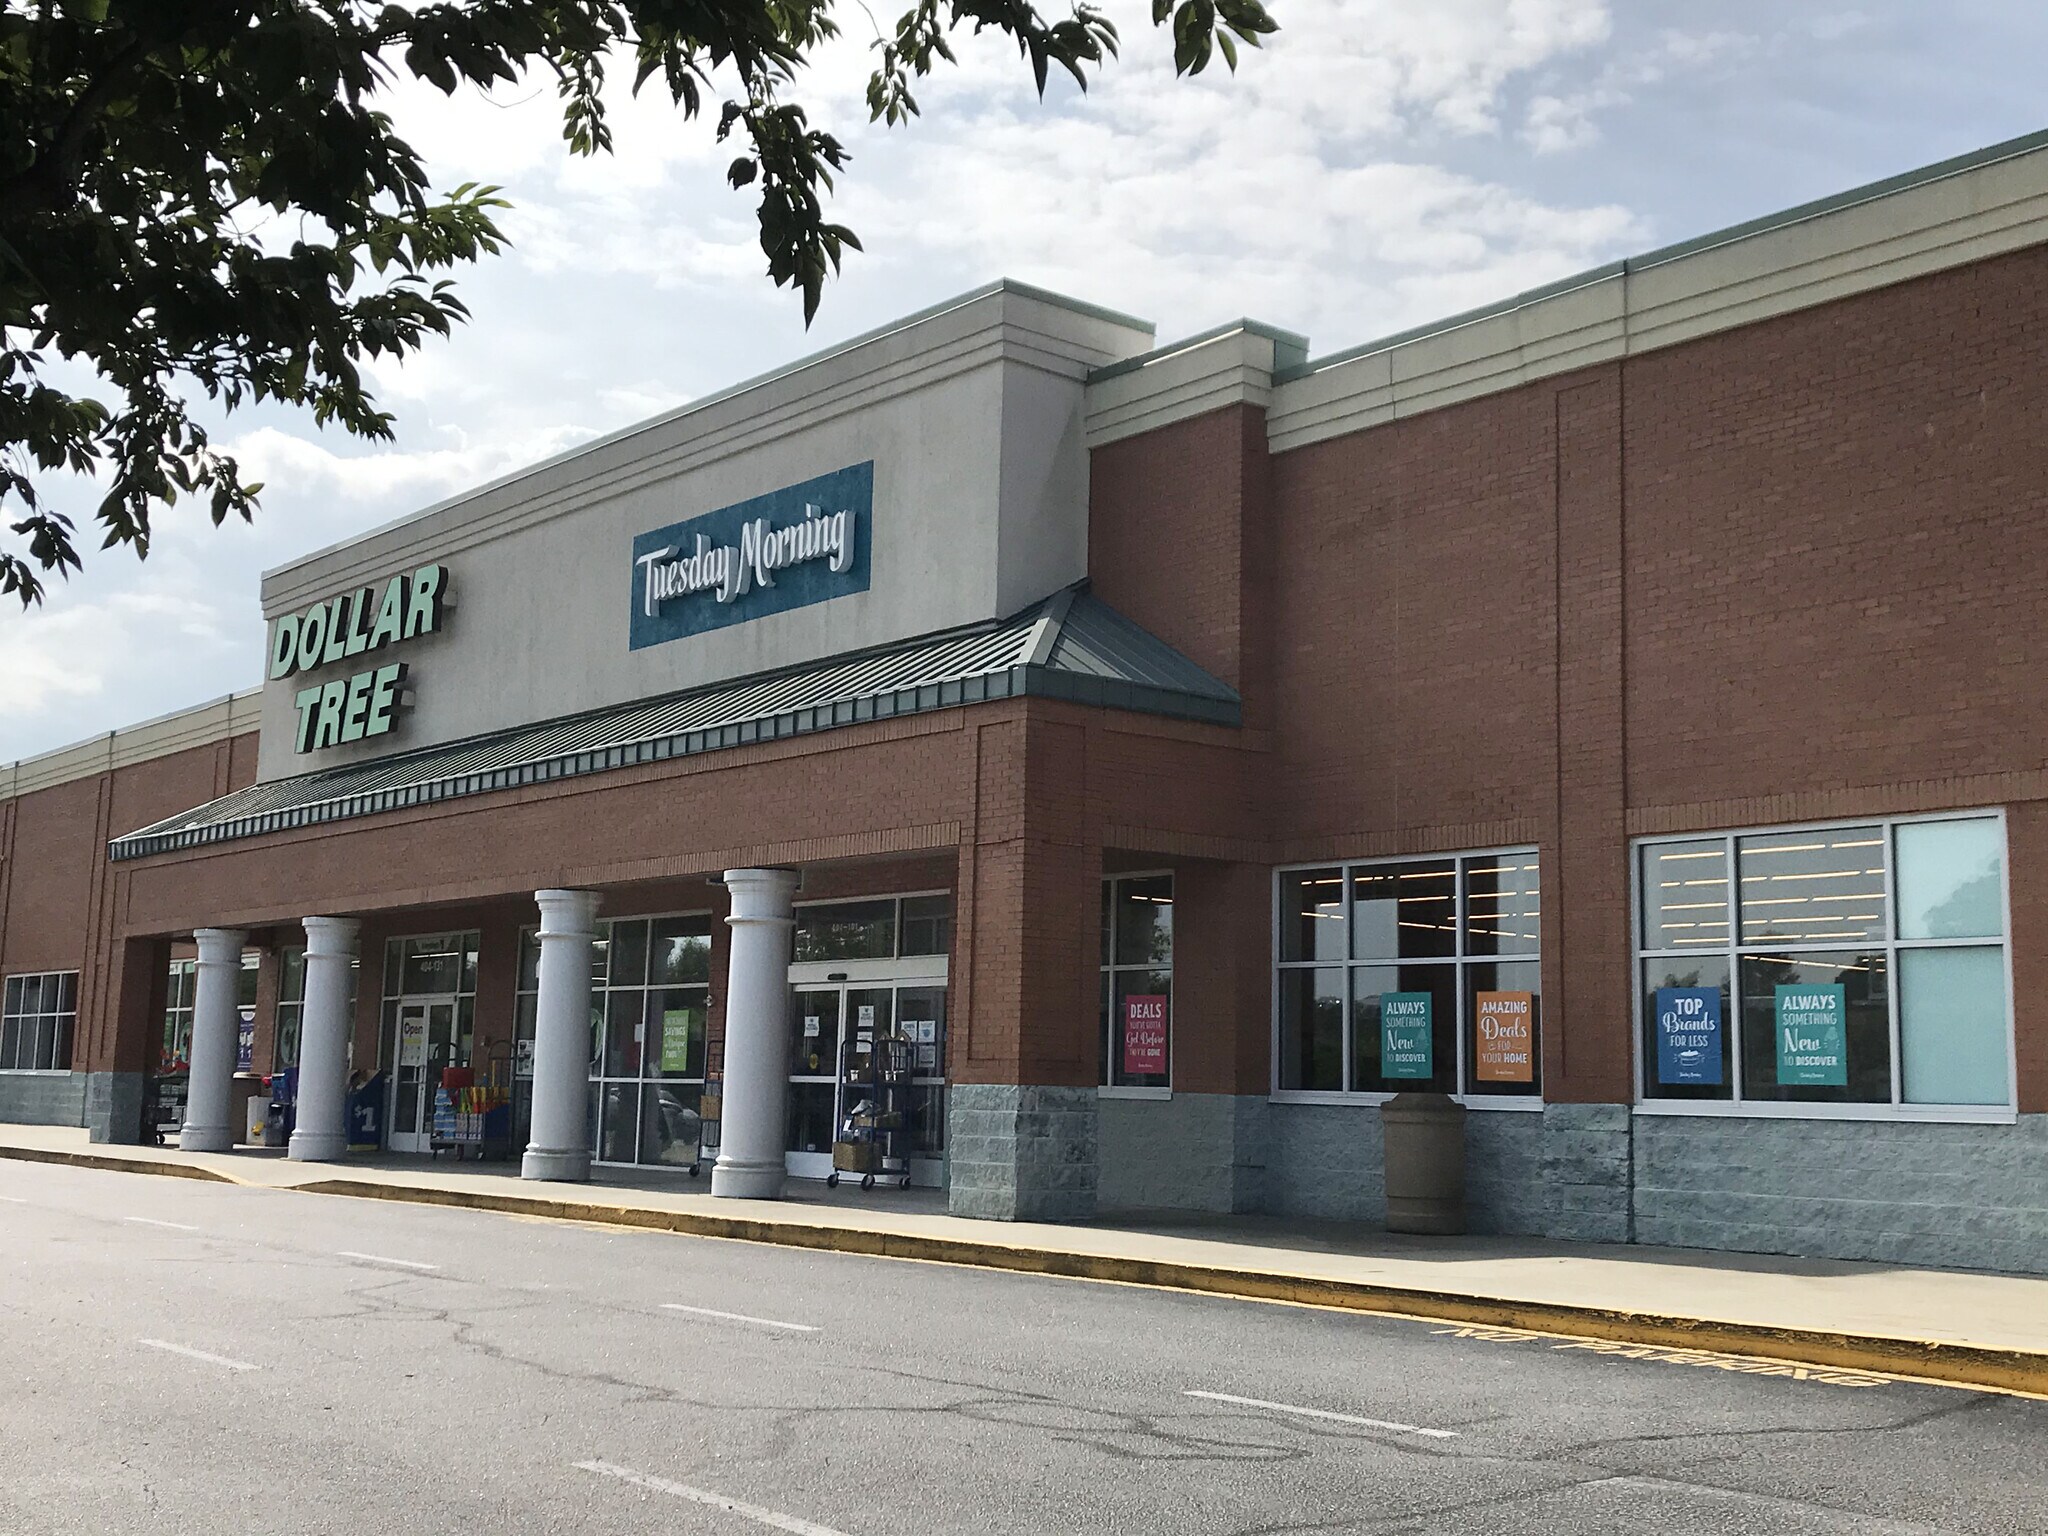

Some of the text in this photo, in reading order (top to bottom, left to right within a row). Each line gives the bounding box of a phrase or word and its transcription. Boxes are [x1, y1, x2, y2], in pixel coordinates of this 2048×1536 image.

[635, 502, 856, 617] Tuesday Morning
[270, 564, 448, 681] DOLLAR
[294, 663, 409, 754] TREE
[1386, 1002, 1425, 1015] ALWAYS
[1481, 1001, 1527, 1014] AMAZING
[1675, 998, 1703, 1015] TOP
[1782, 995, 1836, 1010] ALWAYS
[1130, 1003, 1162, 1019] DEALS
[1782, 1012, 1837, 1025] SOMETHING
[404, 1022, 423, 1035] Open
[1386, 1016, 1426, 1027] SOMETHING
[1481, 1015, 1527, 1040] Deals
[1662, 1011, 1716, 1033] Brands
[1126, 1031, 1165, 1047] Get Before
[1387, 1029, 1414, 1051] New
[1670, 1035, 1708, 1047] FOR LESS
[1784, 1027, 1821, 1053] New
[1147, 1048, 1161, 1056] GONE
[1395, 1053, 1426, 1062] DISCOVER
[1482, 1053, 1527, 1064] YOUR HOME
[1784, 1056, 1838, 1066] TO DISCOVER
[1429, 1327, 1892, 1387] NO PARKING
